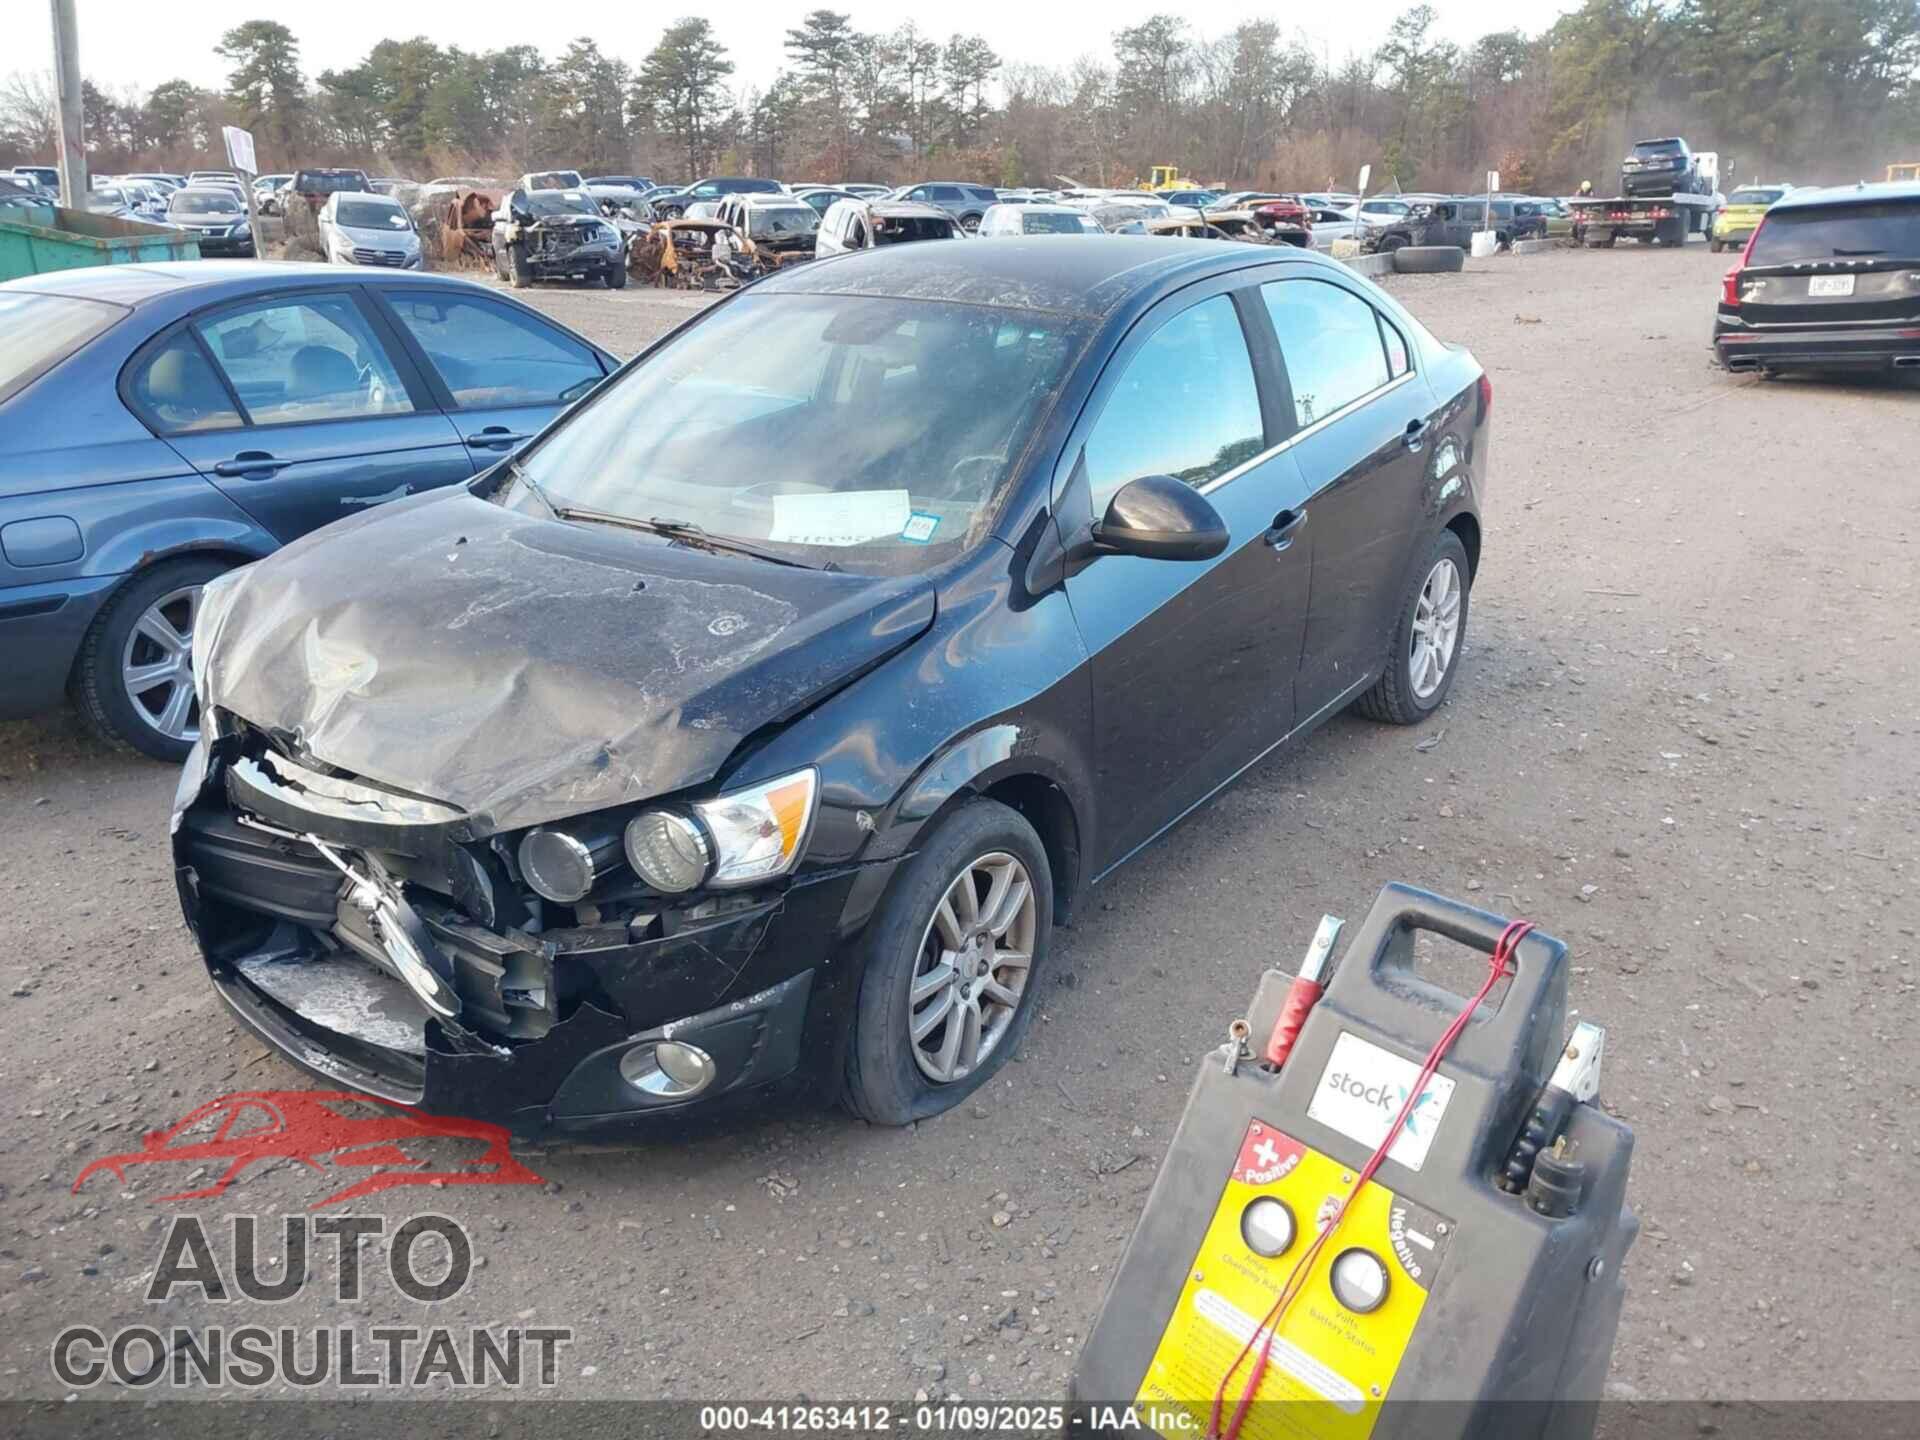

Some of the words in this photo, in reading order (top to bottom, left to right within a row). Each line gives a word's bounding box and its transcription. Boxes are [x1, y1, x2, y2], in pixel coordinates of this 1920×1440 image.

[1245, 1153, 1299, 1182] Positive
[1391, 1207, 1422, 1279] Negative
[1309, 1307, 1343, 1336] Battery
[1345, 1330, 1377, 1356] Status
[1335, 1309, 1359, 1331] Volts
